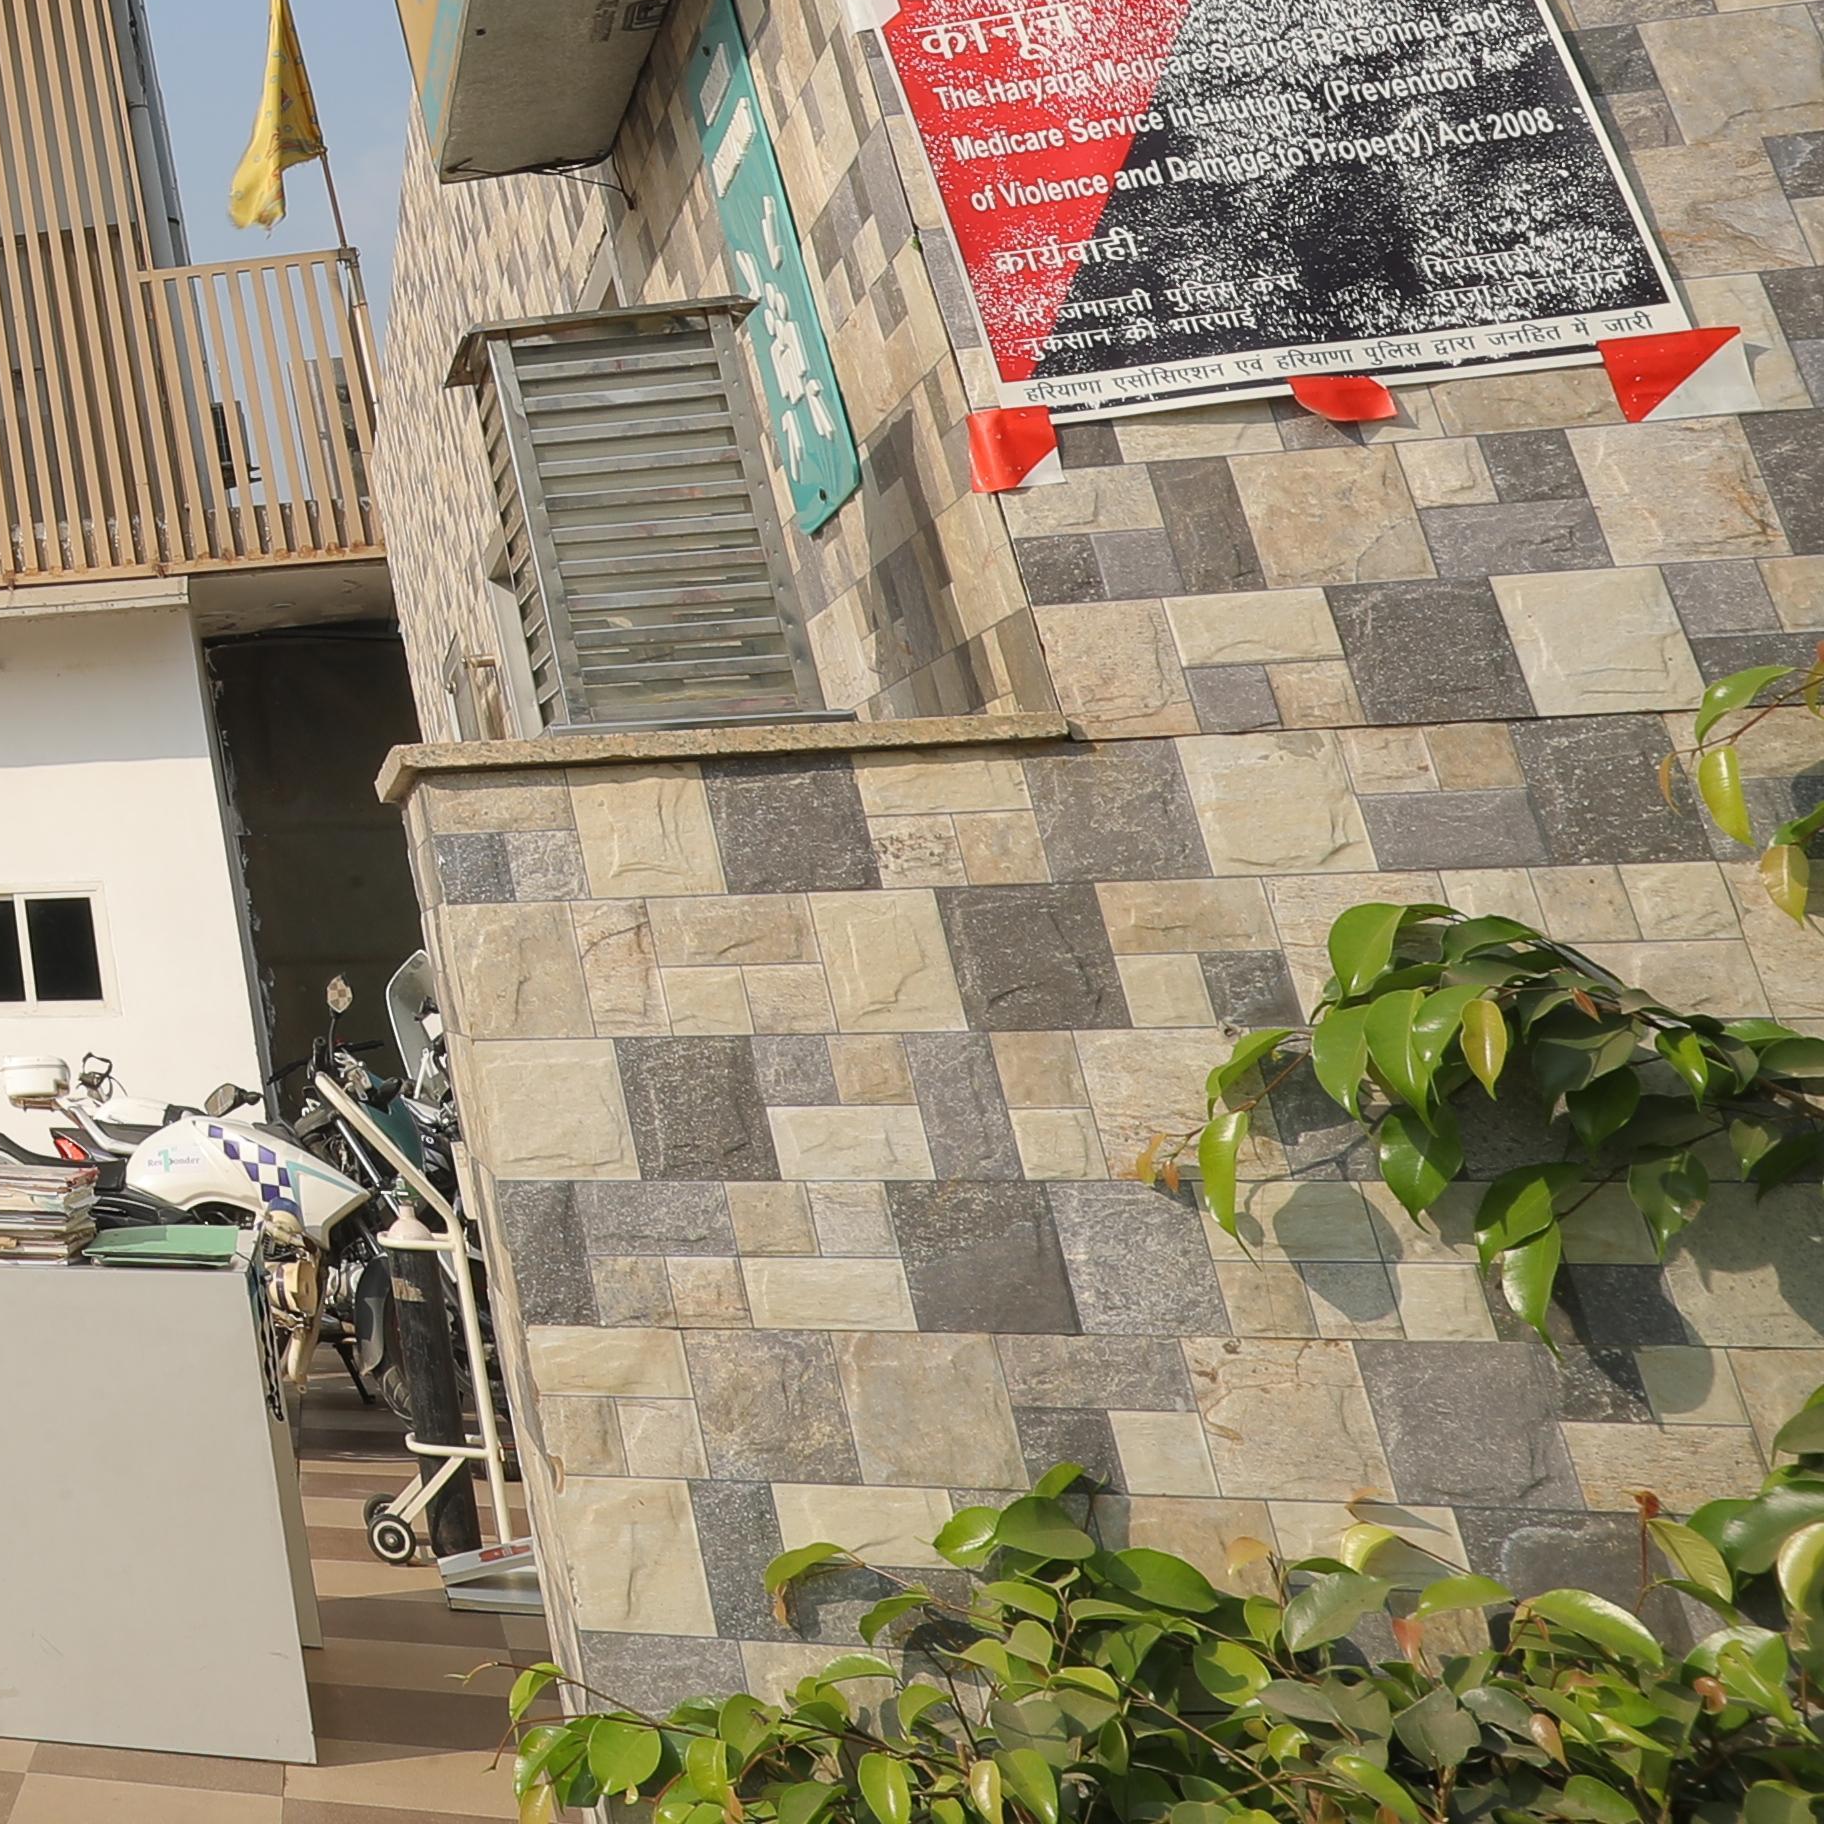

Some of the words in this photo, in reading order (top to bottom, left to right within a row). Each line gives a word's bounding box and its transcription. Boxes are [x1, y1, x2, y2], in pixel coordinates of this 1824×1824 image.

[932, 80, 984, 112] The
[983, 63, 1095, 111] Haryana
[1091, 44, 1210, 87] Medicare
[1208, 30, 1310, 70] Service
[1307, 9, 1446, 56] Personnel
[1444, 3, 1504, 35] and
[948, 120, 1067, 162] Medicare
[1066, 105, 1167, 144] Service
[1319, 59, 1481, 115] (Prevention
[966, 185, 1000, 214] of
[997, 168, 1111, 209] Violence
[1109, 159, 1165, 191] and
[1164, 142, 1278, 191] Damage
[1275, 142, 1308, 168] to
[1304, 120, 1438, 172] Property)
[1431, 117, 1487, 149] Act
[1482, 105, 1566, 141] 2008.
[1053, 286, 1155, 324] जमानती
[1022, 374, 1104, 405] हरियाणा
[1109, 355, 1227, 395] एसोसिएशन
[1232, 352, 1267, 377] एवं
[1270, 341, 1356, 373] हरियाणा
[1361, 335, 1425, 366] पुलिस
[1430, 332, 1479, 357] द्वारा
[1482, 319, 1564, 351] जनहित
[1566, 314, 1595, 339] में
[1600, 309, 1656, 335] जारी
